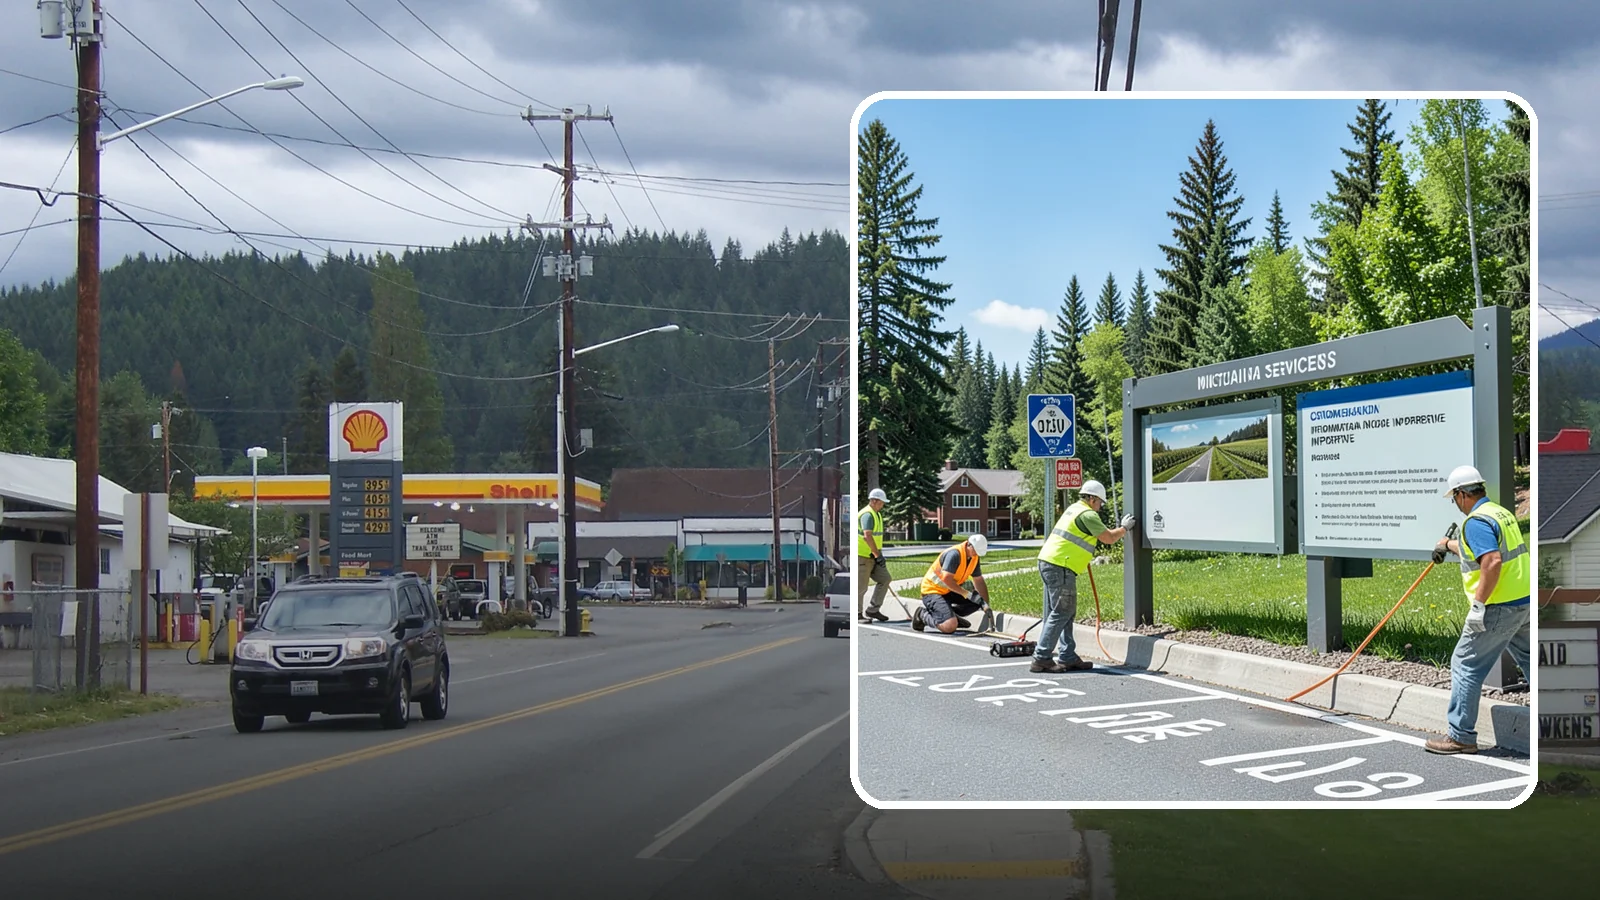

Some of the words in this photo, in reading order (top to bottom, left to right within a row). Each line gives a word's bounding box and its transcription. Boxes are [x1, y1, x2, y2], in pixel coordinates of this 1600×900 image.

[365, 480, 383, 490] 395
[489, 484, 548, 499] Shell
[365, 494, 384, 504] 405
[365, 508, 383, 518] 415
[365, 522, 384, 532] 429
